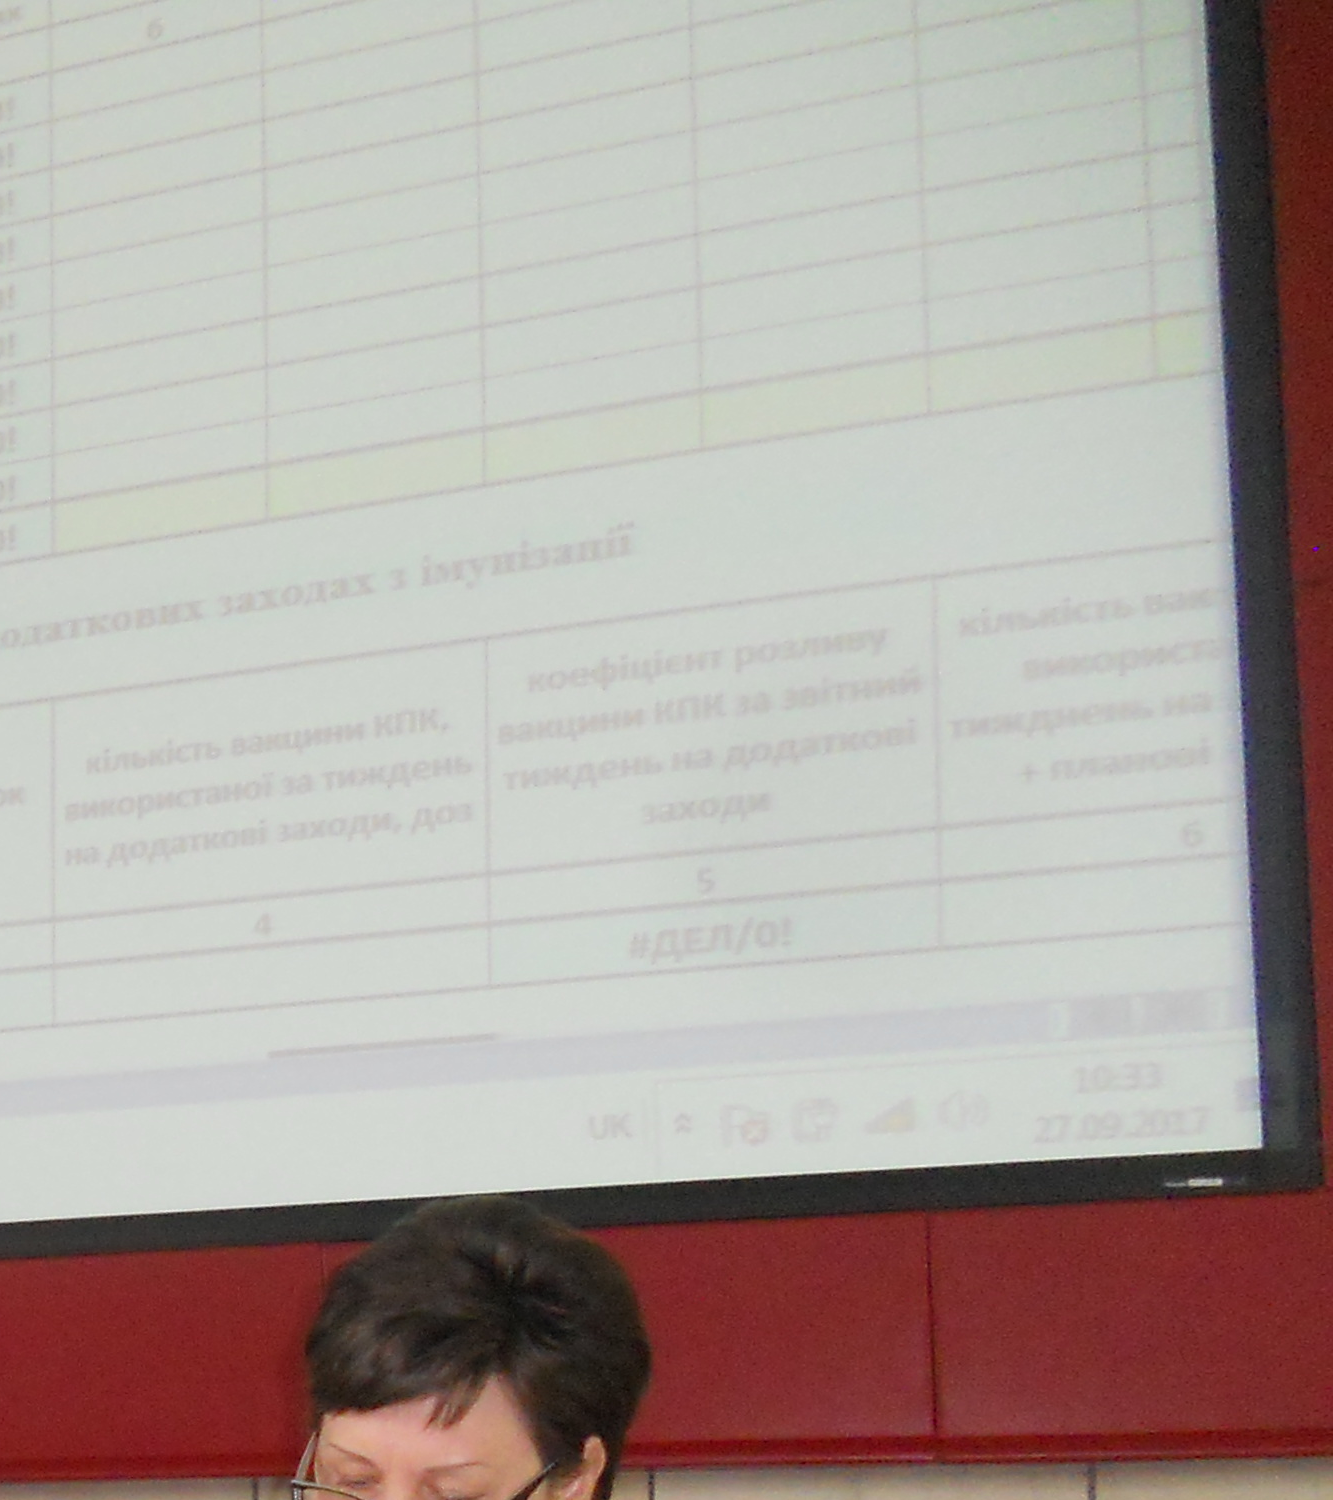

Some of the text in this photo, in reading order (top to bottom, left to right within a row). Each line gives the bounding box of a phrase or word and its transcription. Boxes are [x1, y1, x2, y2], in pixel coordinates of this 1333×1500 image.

[216, 569, 378, 618] заходах
[388, 566, 408, 592] з
[420, 520, 637, 590] імунізації
[525, 627, 892, 695] коефіцієнт розливу
[496, 664, 924, 747] вакцини КПК за звітний
[84, 705, 451, 776] кількість вакцини КПК,
[502, 716, 920, 792] тиждень на додаткові
[63, 753, 474, 823] використаної за тиждень
[641, 791, 775, 827] заходи
[64, 800, 475, 869] на додаткові заходи, доз
[695, 866, 716, 895] 5
[253, 912, 274, 937] 4
[587, 1111, 633, 1140] UK
